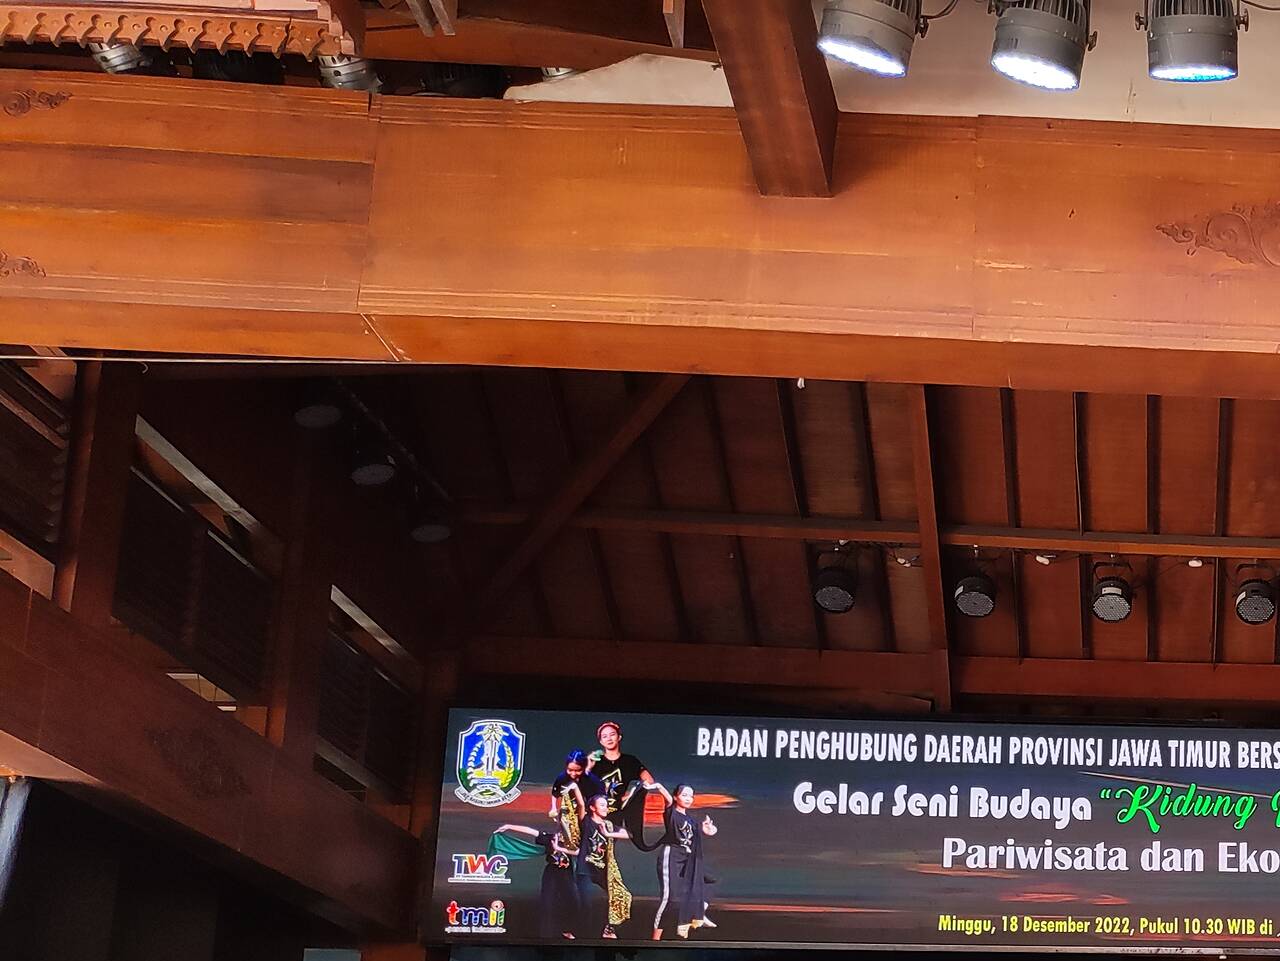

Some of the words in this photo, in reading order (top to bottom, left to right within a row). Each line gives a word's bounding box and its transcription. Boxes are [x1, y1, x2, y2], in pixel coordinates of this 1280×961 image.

[696, 727, 769, 758] BADAN
[775, 729, 918, 761] PENGHUBUNG
[923, 734, 1002, 764] DAERAH
[1008, 736, 1103, 767] PROVINSI
[1108, 738, 1163, 767] JAWA
[1167, 739, 1231, 769] TIMUR
[792, 781, 884, 816] Gelar
[891, 784, 959, 818] Seni
[969, 786, 1092, 830] Budaya
[1100, 783, 1258, 833] “Kidung
[453, 854, 509, 875] TWC
[942, 837, 1130, 871] Pariwisata
[1140, 840, 1205, 872] dan
[938, 914, 996, 936] Minggu,
[1001, 915, 1019, 933] 18
[1023, 915, 1091, 933] Desember
[1094, 916, 1135, 937] 2022,
[1139, 916, 1179, 934] Pukul
[1183, 917, 1224, 935] 10.30
[1226, 918, 1256, 935] WIB
[1259, 918, 1273, 936] di
